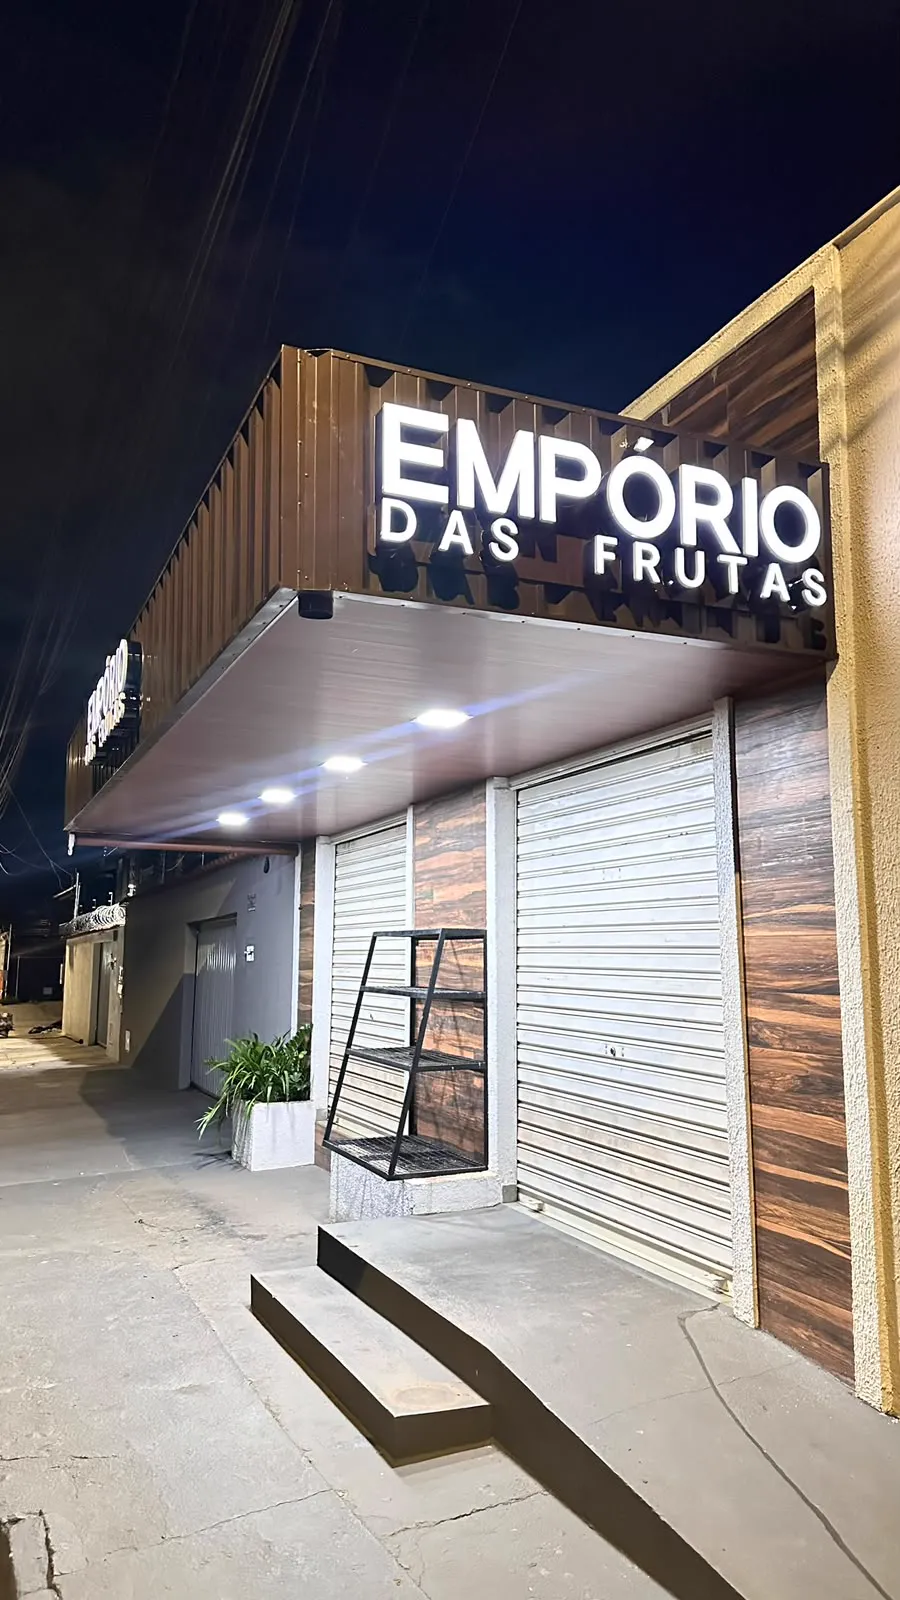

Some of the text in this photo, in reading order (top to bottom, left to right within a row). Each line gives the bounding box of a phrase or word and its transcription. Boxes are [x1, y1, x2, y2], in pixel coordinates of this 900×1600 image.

[380, 402, 821, 564] EMPÓRIO
[380, 497, 828, 607] DAS FRUTAS
